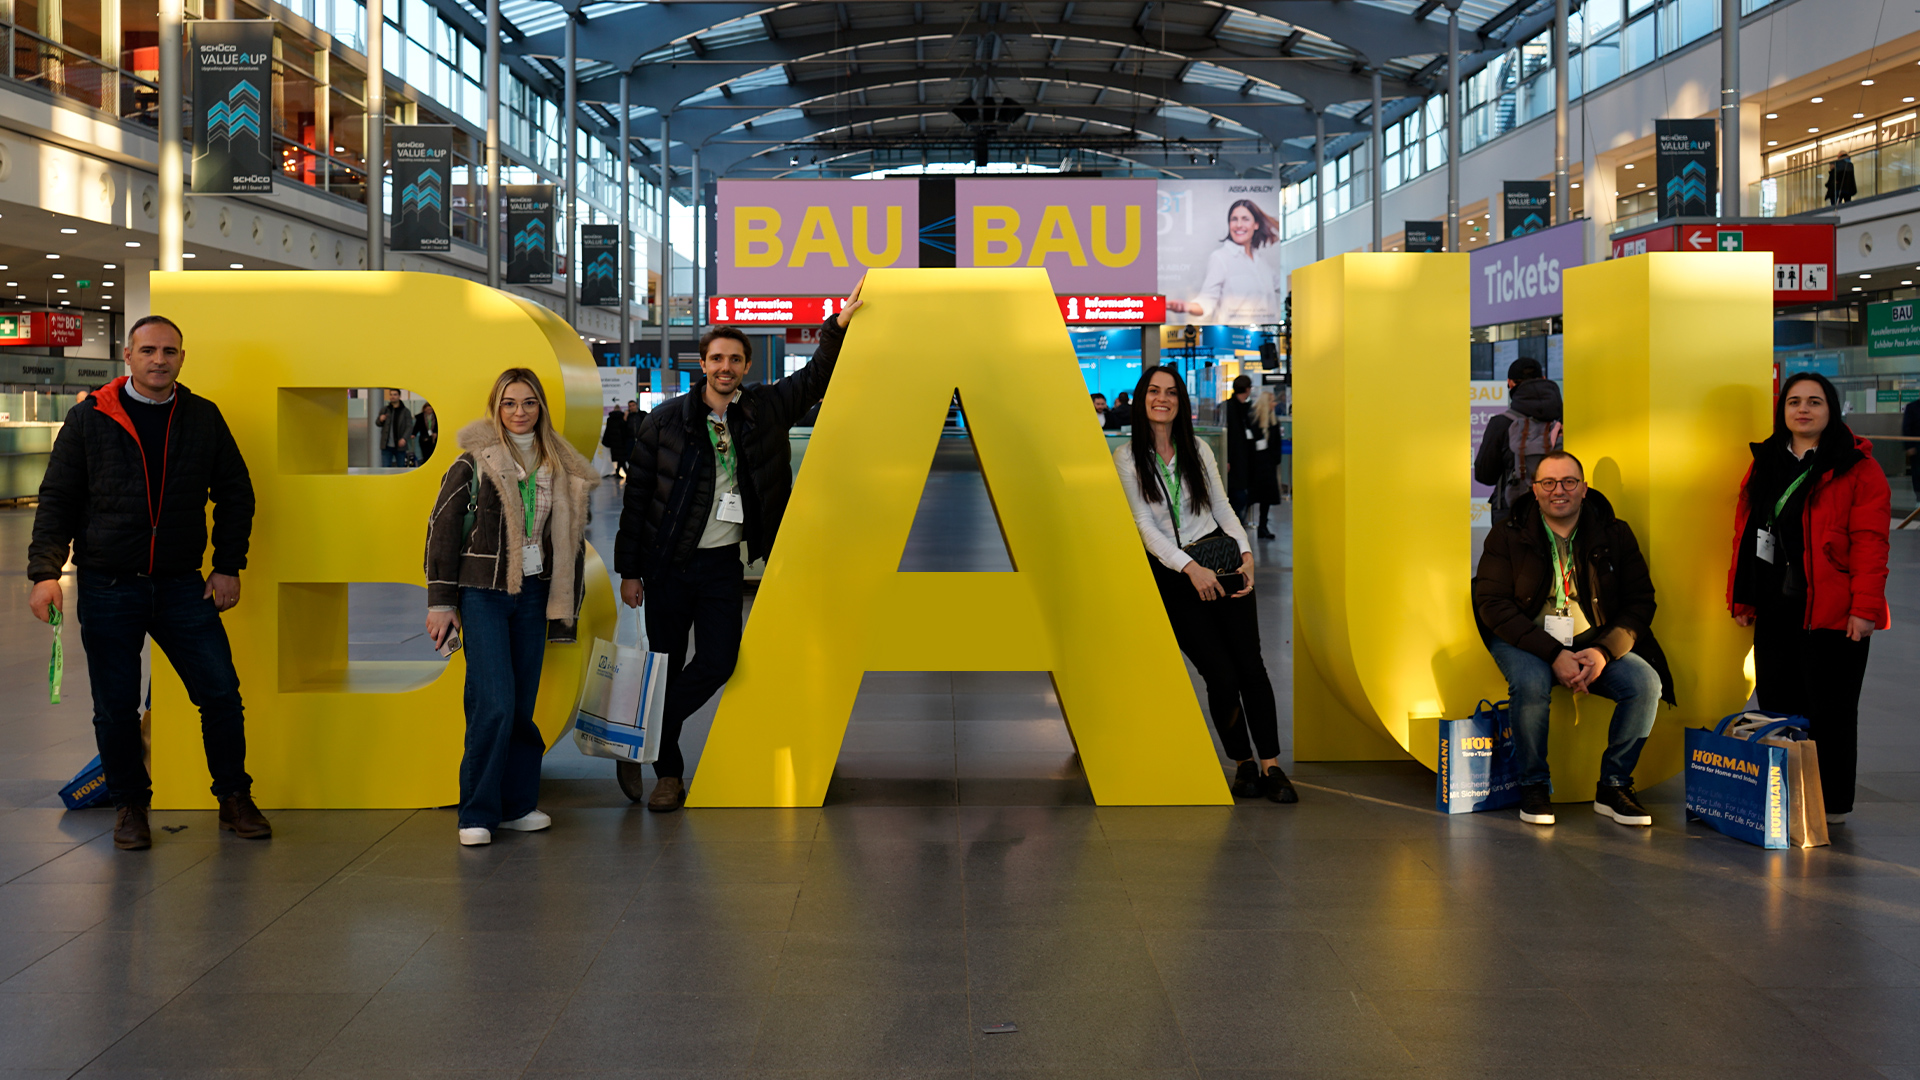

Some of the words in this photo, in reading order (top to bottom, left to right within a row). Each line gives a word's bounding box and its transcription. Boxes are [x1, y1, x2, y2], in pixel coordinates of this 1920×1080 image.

[200, 43, 237, 52] SCHÜCO
[200, 53, 239, 65] VALUE
[250, 53, 267, 65] UP
[1661, 141, 1690, 150] VALUE
[1697, 141, 1711, 150] UP
[397, 149, 426, 158] VALUE
[434, 149, 447, 158] UP
[233, 174, 270, 183] SCHÜCO
[1228, 185, 1248, 193] ASSA
[1249, 185, 1274, 193] ABLOY
[1508, 198, 1530, 206] VALUE
[734, 206, 902, 268] BAU
[973, 205, 1141, 268] BAU
[1484, 253, 1560, 305] Tickets
[734, 298, 793, 309] Information
[1085, 297, 1144, 308] Information
[735, 309, 793, 321] Information
[1085, 308, 1144, 319] Information
[1892, 305, 1913, 321] BAU
[23, 365, 55, 375] SUPERMARKT
[78, 369, 108, 377] SUPERMARKET
[1692, 749, 1760, 777] HÖRMANN
[1691, 762, 1706, 772] Doors
[1706, 766, 1714, 774] for
[1715, 768, 1732, 778] Home
[1696, 804, 1707, 814] For
[1708, 808, 1723, 818] Life.
[1725, 811, 1735, 821] For
[1735, 815, 1745, 825] Life.
[1746, 818, 1755, 828] For
